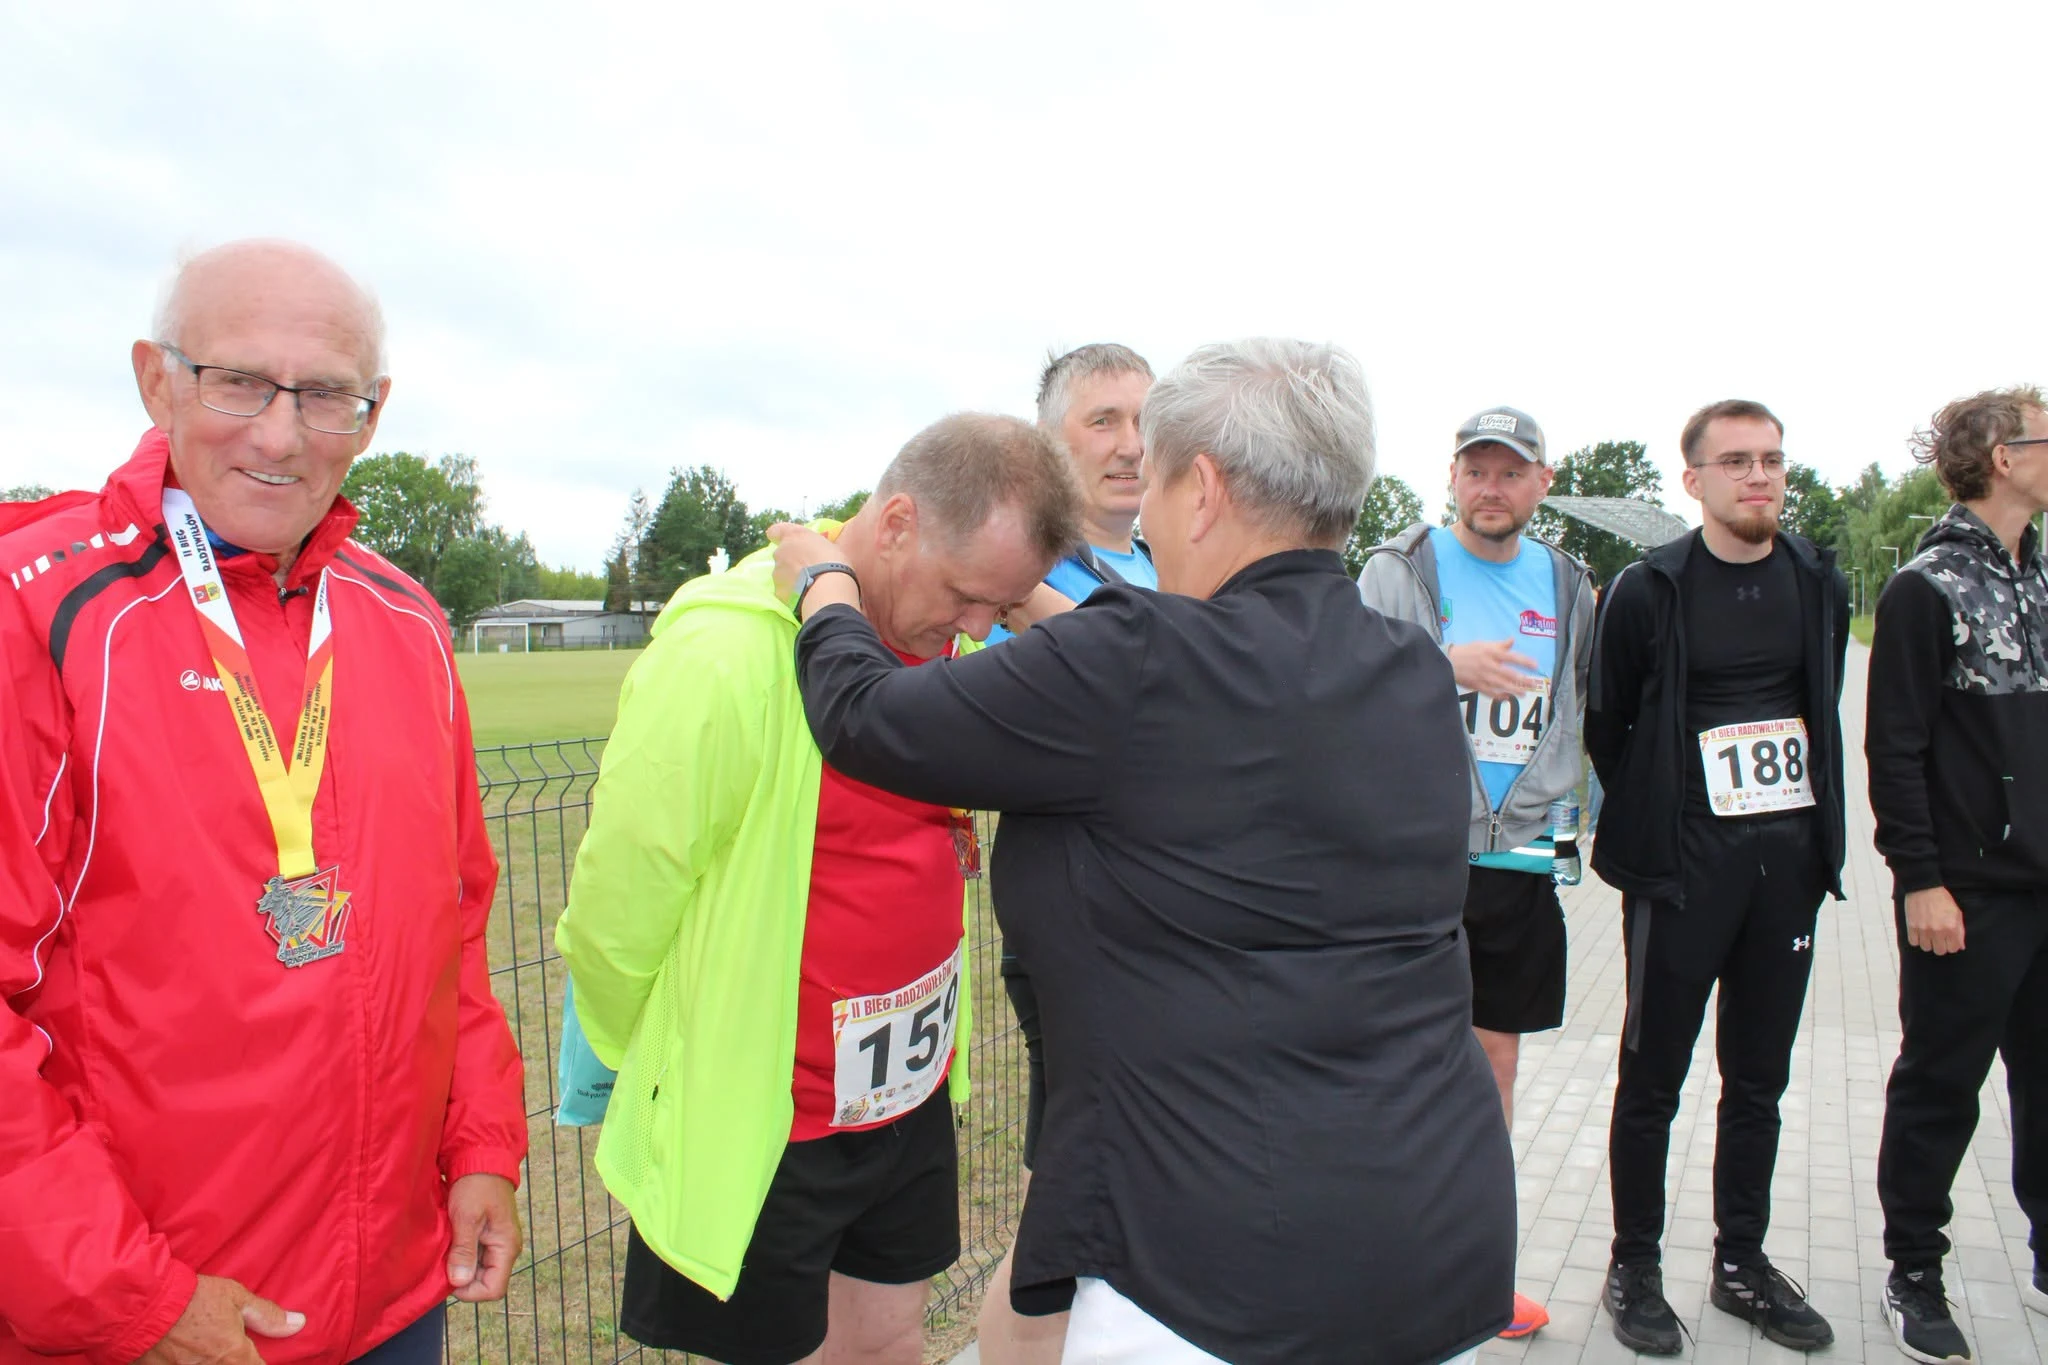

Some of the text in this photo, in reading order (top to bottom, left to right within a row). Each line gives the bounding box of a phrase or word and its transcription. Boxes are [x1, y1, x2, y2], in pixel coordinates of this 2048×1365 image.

[176, 529, 192, 557] II BIEG
[184, 513, 212, 572] RADZIWIŁŁÓW
[1459, 690, 1542, 740] 104
[1718, 727, 1736, 738] BIEG
[1738, 721, 1785, 736] RADZIWIŁŁÓW
[1718, 737, 1803, 789] 188
[851, 1001, 860, 1019] II
[864, 998, 892, 1017] BIEG
[895, 961, 953, 1008] RADZIWIŁŁÓW
[859, 972, 958, 1090] 159
